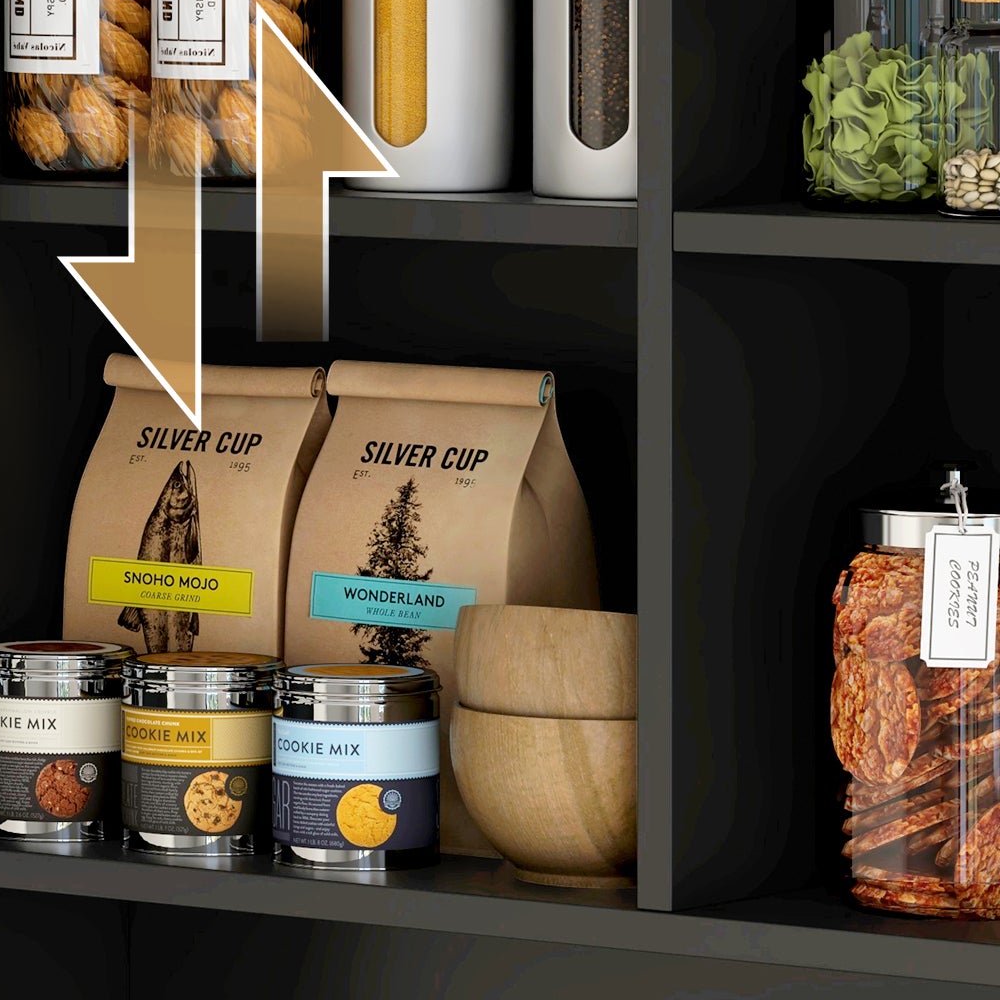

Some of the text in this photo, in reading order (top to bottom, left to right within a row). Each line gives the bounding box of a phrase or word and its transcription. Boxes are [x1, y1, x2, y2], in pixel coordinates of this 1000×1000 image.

[137, 427, 263, 455] SILVER CUP
[360, 441, 490, 472] SILVER CUP
[229, 461, 251, 472] 1995
[124, 571, 219, 591] SNOHO MOJO
[140, 591, 201, 603] COARSE GRIND
[344, 586, 445, 608] WONDERLAND
[948, 559, 961, 628] COOKIES
[965, 560, 980, 628] PEANUT
[366, 607, 422, 619] WHOLE BEAN
[27, 717, 57, 730] MIX
[126, 725, 206, 743] COOKIE MIX
[277, 738, 360, 756] COOKIE MIX
